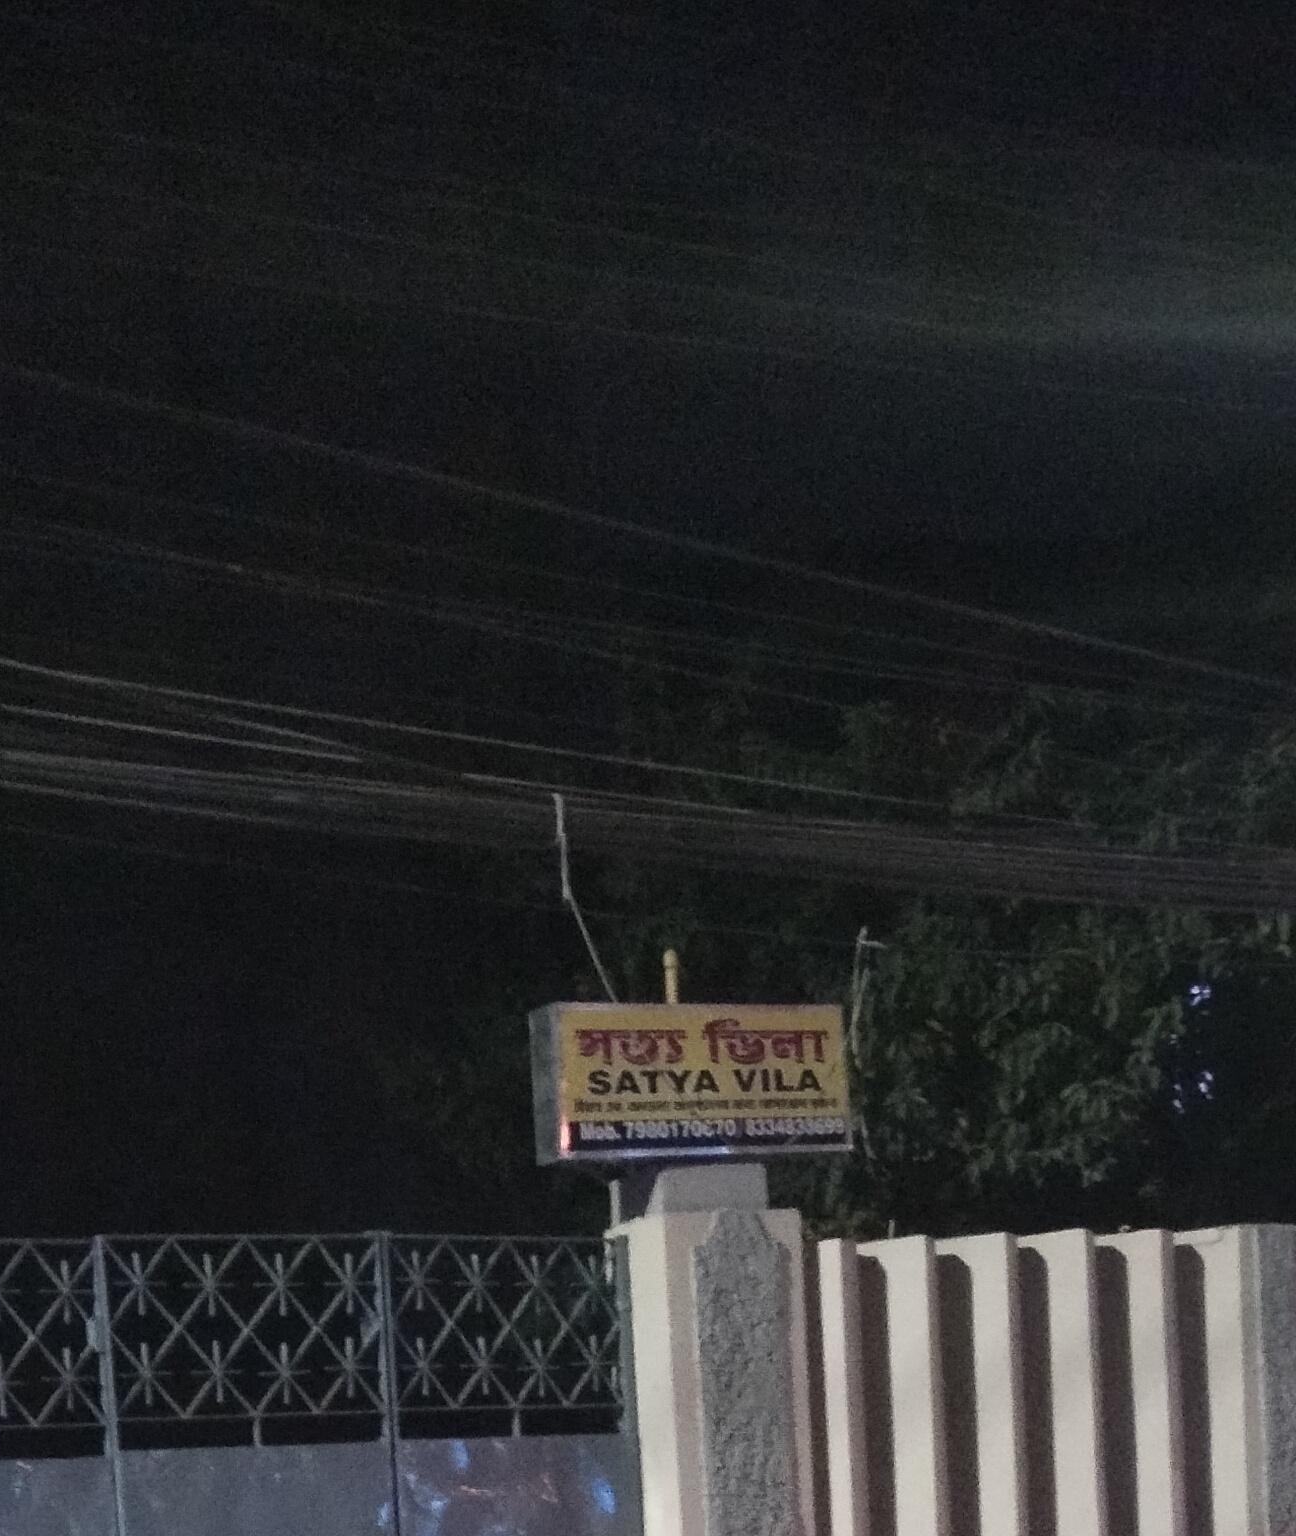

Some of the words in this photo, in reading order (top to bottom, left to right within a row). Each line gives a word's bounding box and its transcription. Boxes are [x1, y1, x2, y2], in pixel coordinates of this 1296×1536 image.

[575, 1028, 687, 1066] সত্য
[702, 1018, 828, 1065] ভিলা
[587, 1069, 720, 1095] SATYA
[733, 1068, 822, 1093] VILA
